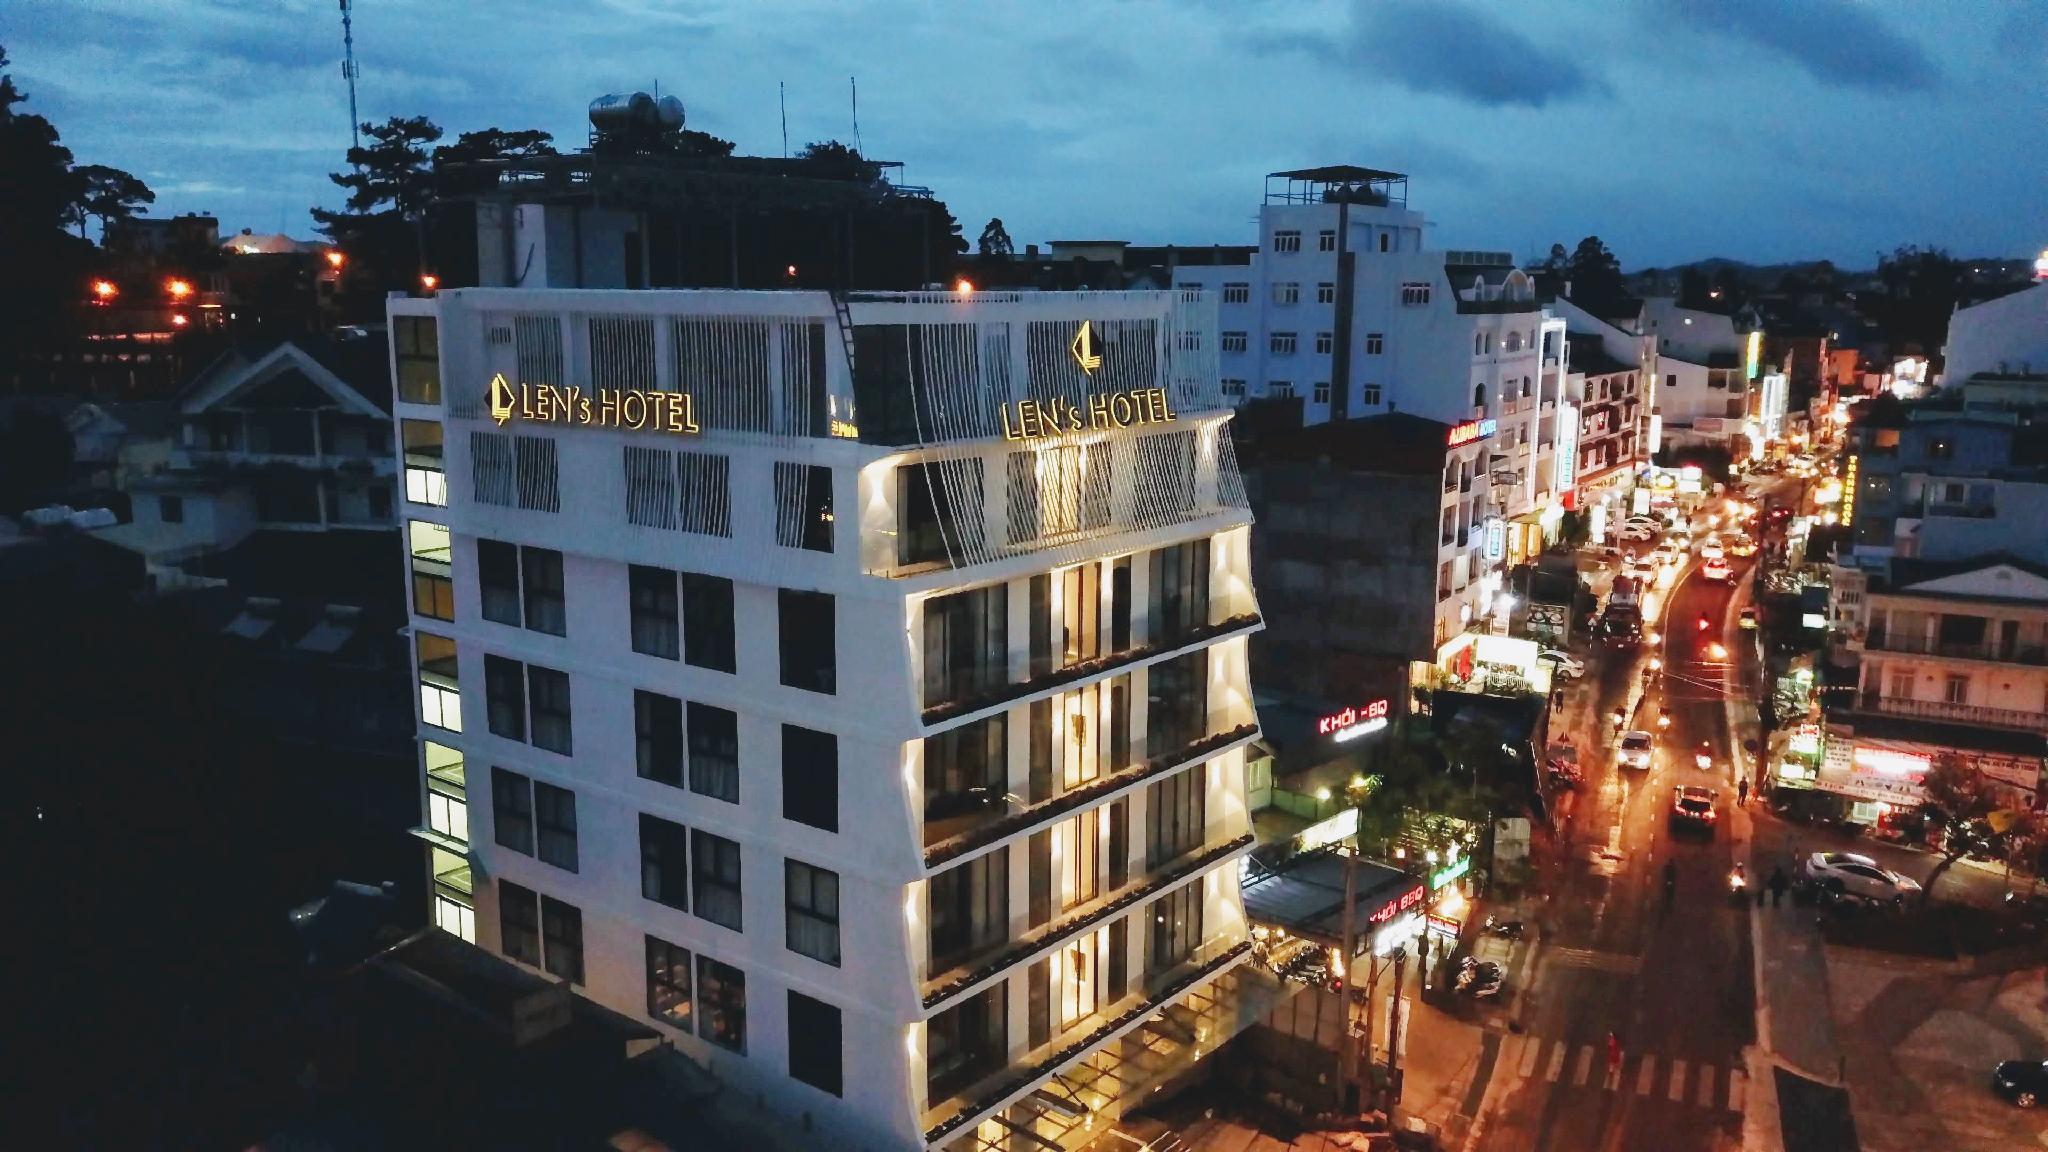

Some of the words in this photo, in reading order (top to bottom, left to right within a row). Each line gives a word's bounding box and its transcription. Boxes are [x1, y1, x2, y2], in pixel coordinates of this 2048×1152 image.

[521, 383, 592, 424] LEN's
[600, 388, 699, 434] HOTEL
[1002, 395, 1082, 440] LEN's
[1090, 388, 1176, 430] HOTEL
[1400, 886, 1424, 910] BBQ
